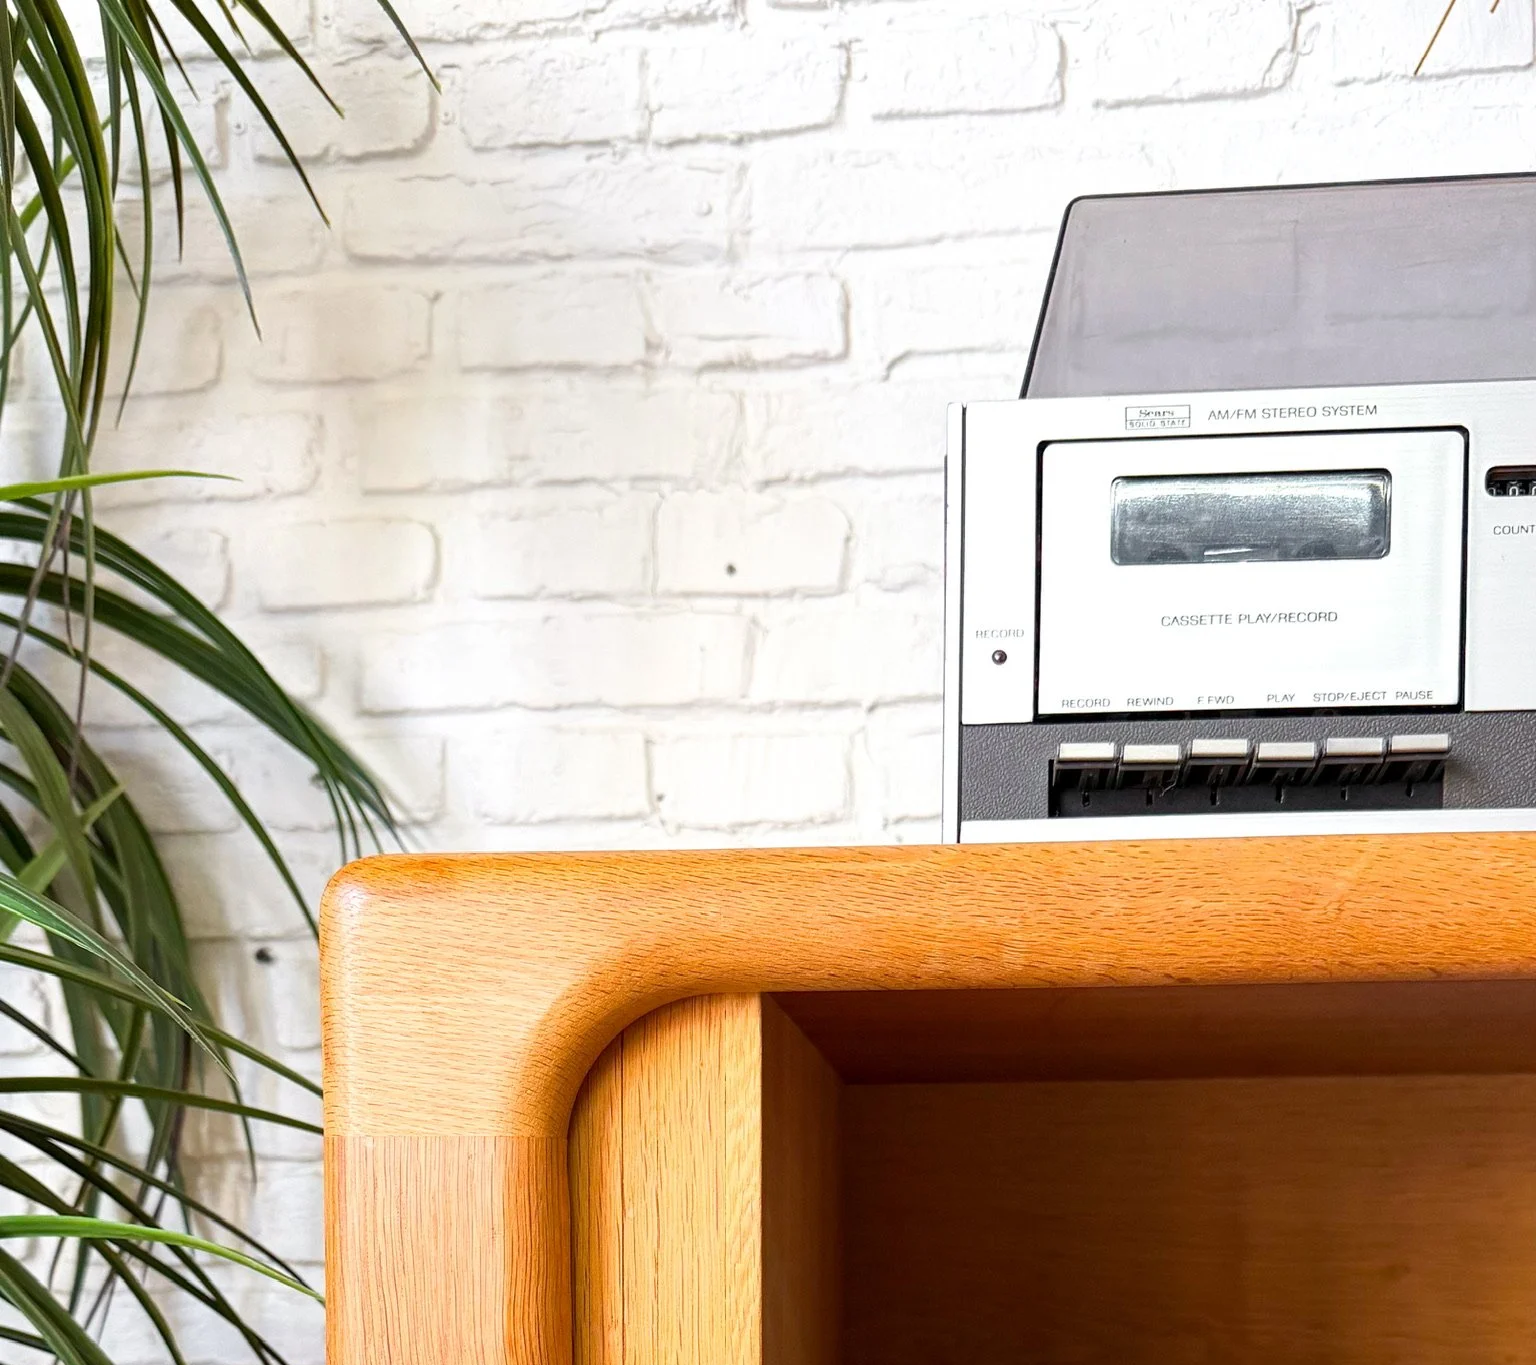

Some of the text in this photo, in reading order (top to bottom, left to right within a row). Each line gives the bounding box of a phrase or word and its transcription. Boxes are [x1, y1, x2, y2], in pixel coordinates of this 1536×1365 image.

[1208, 404, 1378, 421] AM/FM STEREO SYSTEM
[1161, 611, 1338, 627] CASSETTE PLAY/RECORD
[975, 628, 1025, 639] RECORD
[1267, 693, 1295, 703] PLAY
[1313, 691, 1386, 702] STOP/EJECT
[1395, 690, 1433, 700] PAUSE
[1062, 698, 1111, 709] RECORD
[1127, 696, 1174, 707] REWIND
